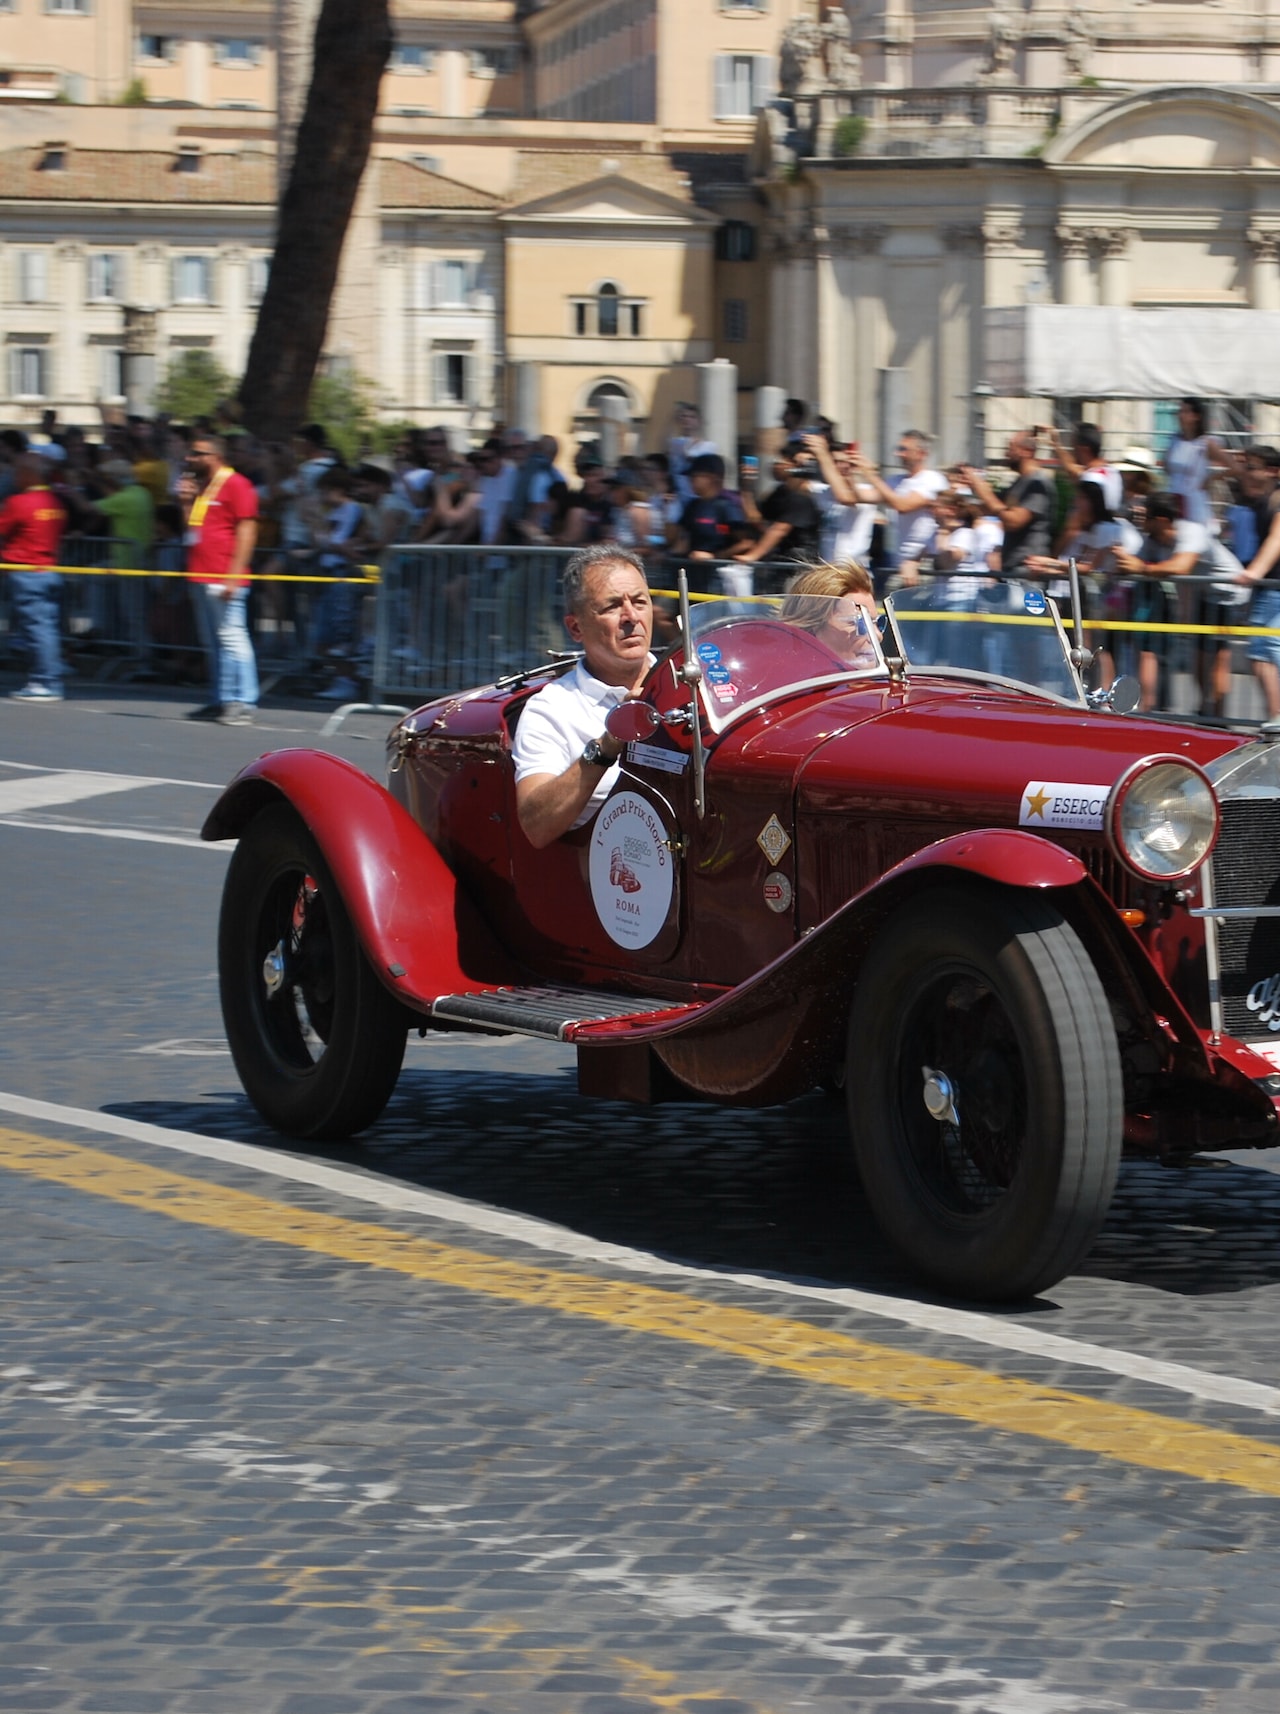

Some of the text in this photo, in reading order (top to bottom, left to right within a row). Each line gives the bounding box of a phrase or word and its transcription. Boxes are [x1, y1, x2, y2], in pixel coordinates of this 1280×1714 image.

[602, 799, 627, 830] Grand
[628, 800, 647, 821] Prix
[645, 815, 666, 867] Storico
[615, 898, 641, 916] ROMA
